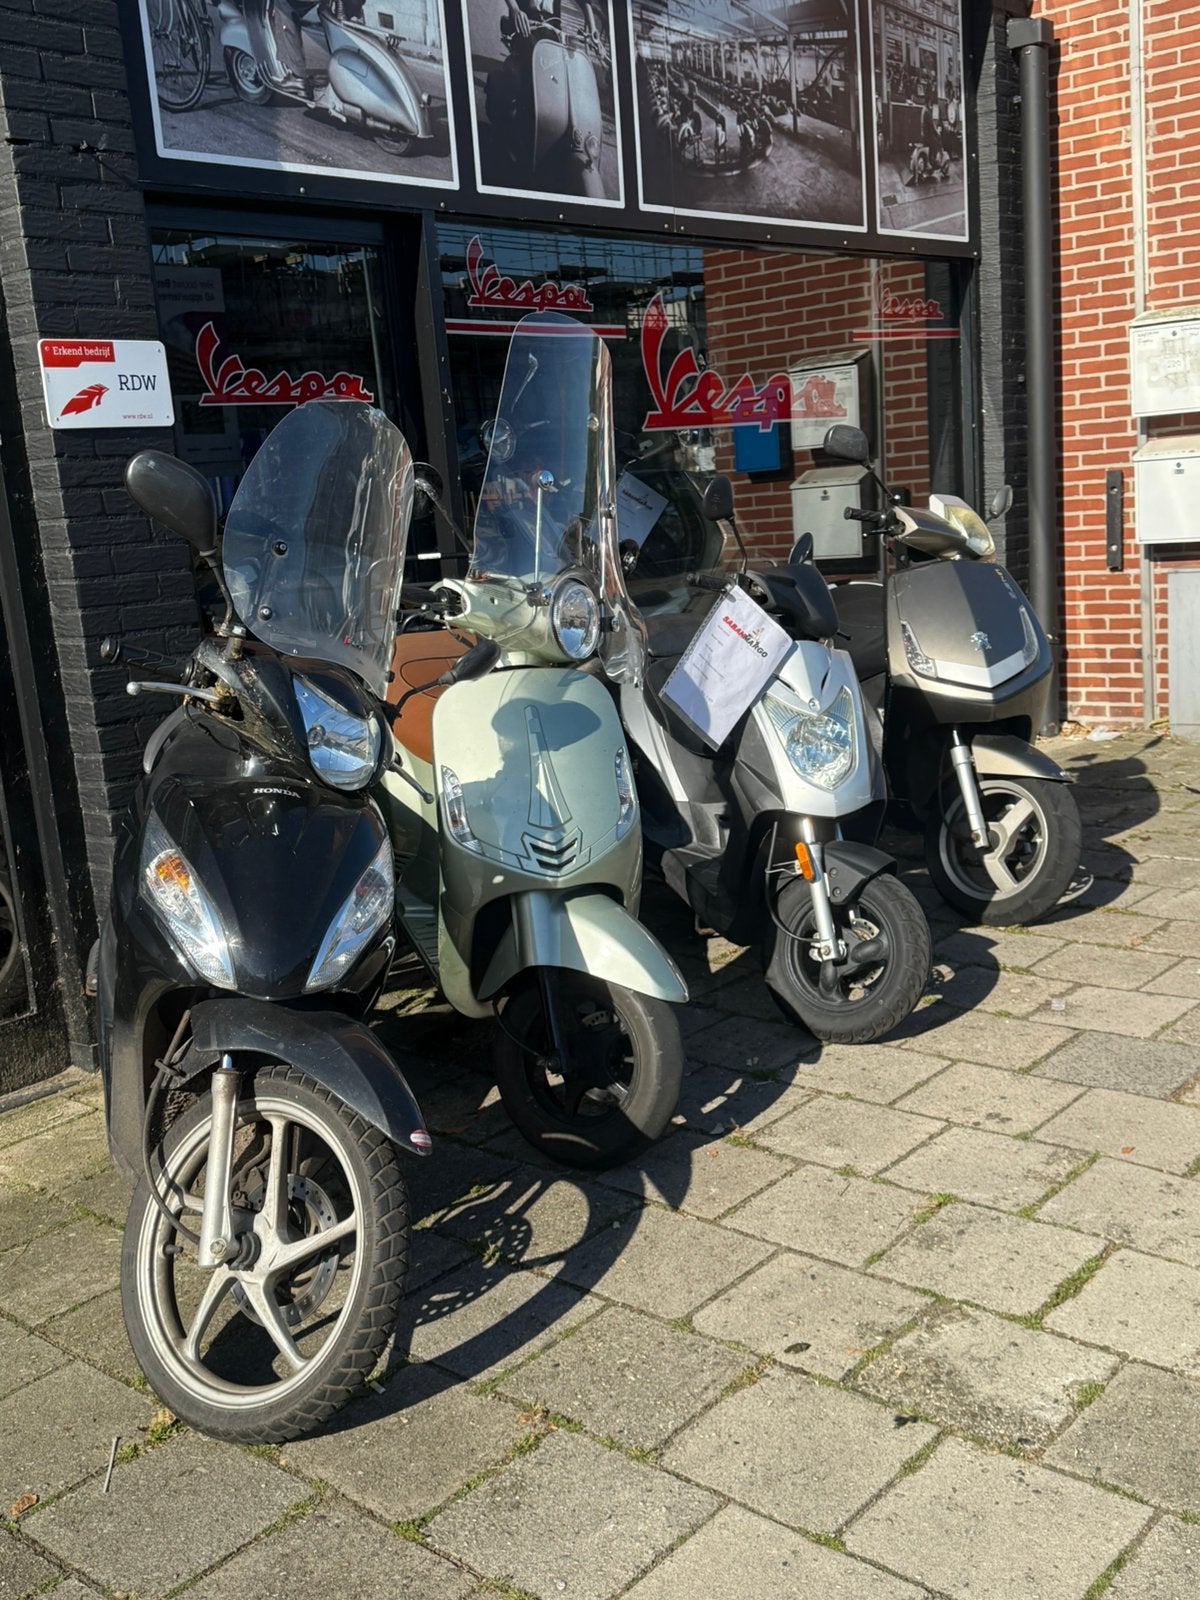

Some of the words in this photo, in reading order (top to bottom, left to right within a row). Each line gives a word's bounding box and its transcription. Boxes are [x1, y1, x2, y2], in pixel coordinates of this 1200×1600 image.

[467, 234, 594, 312] Vespa
[872, 267, 945, 323] Vespa
[52, 346, 83, 356] Erkend
[84, 347, 111, 358] bedrijf
[196, 321, 375, 408] Vespa
[641, 290, 848, 433] Vespa
[117, 374, 157, 391] RDW
[253, 788, 302, 798] HONDA
